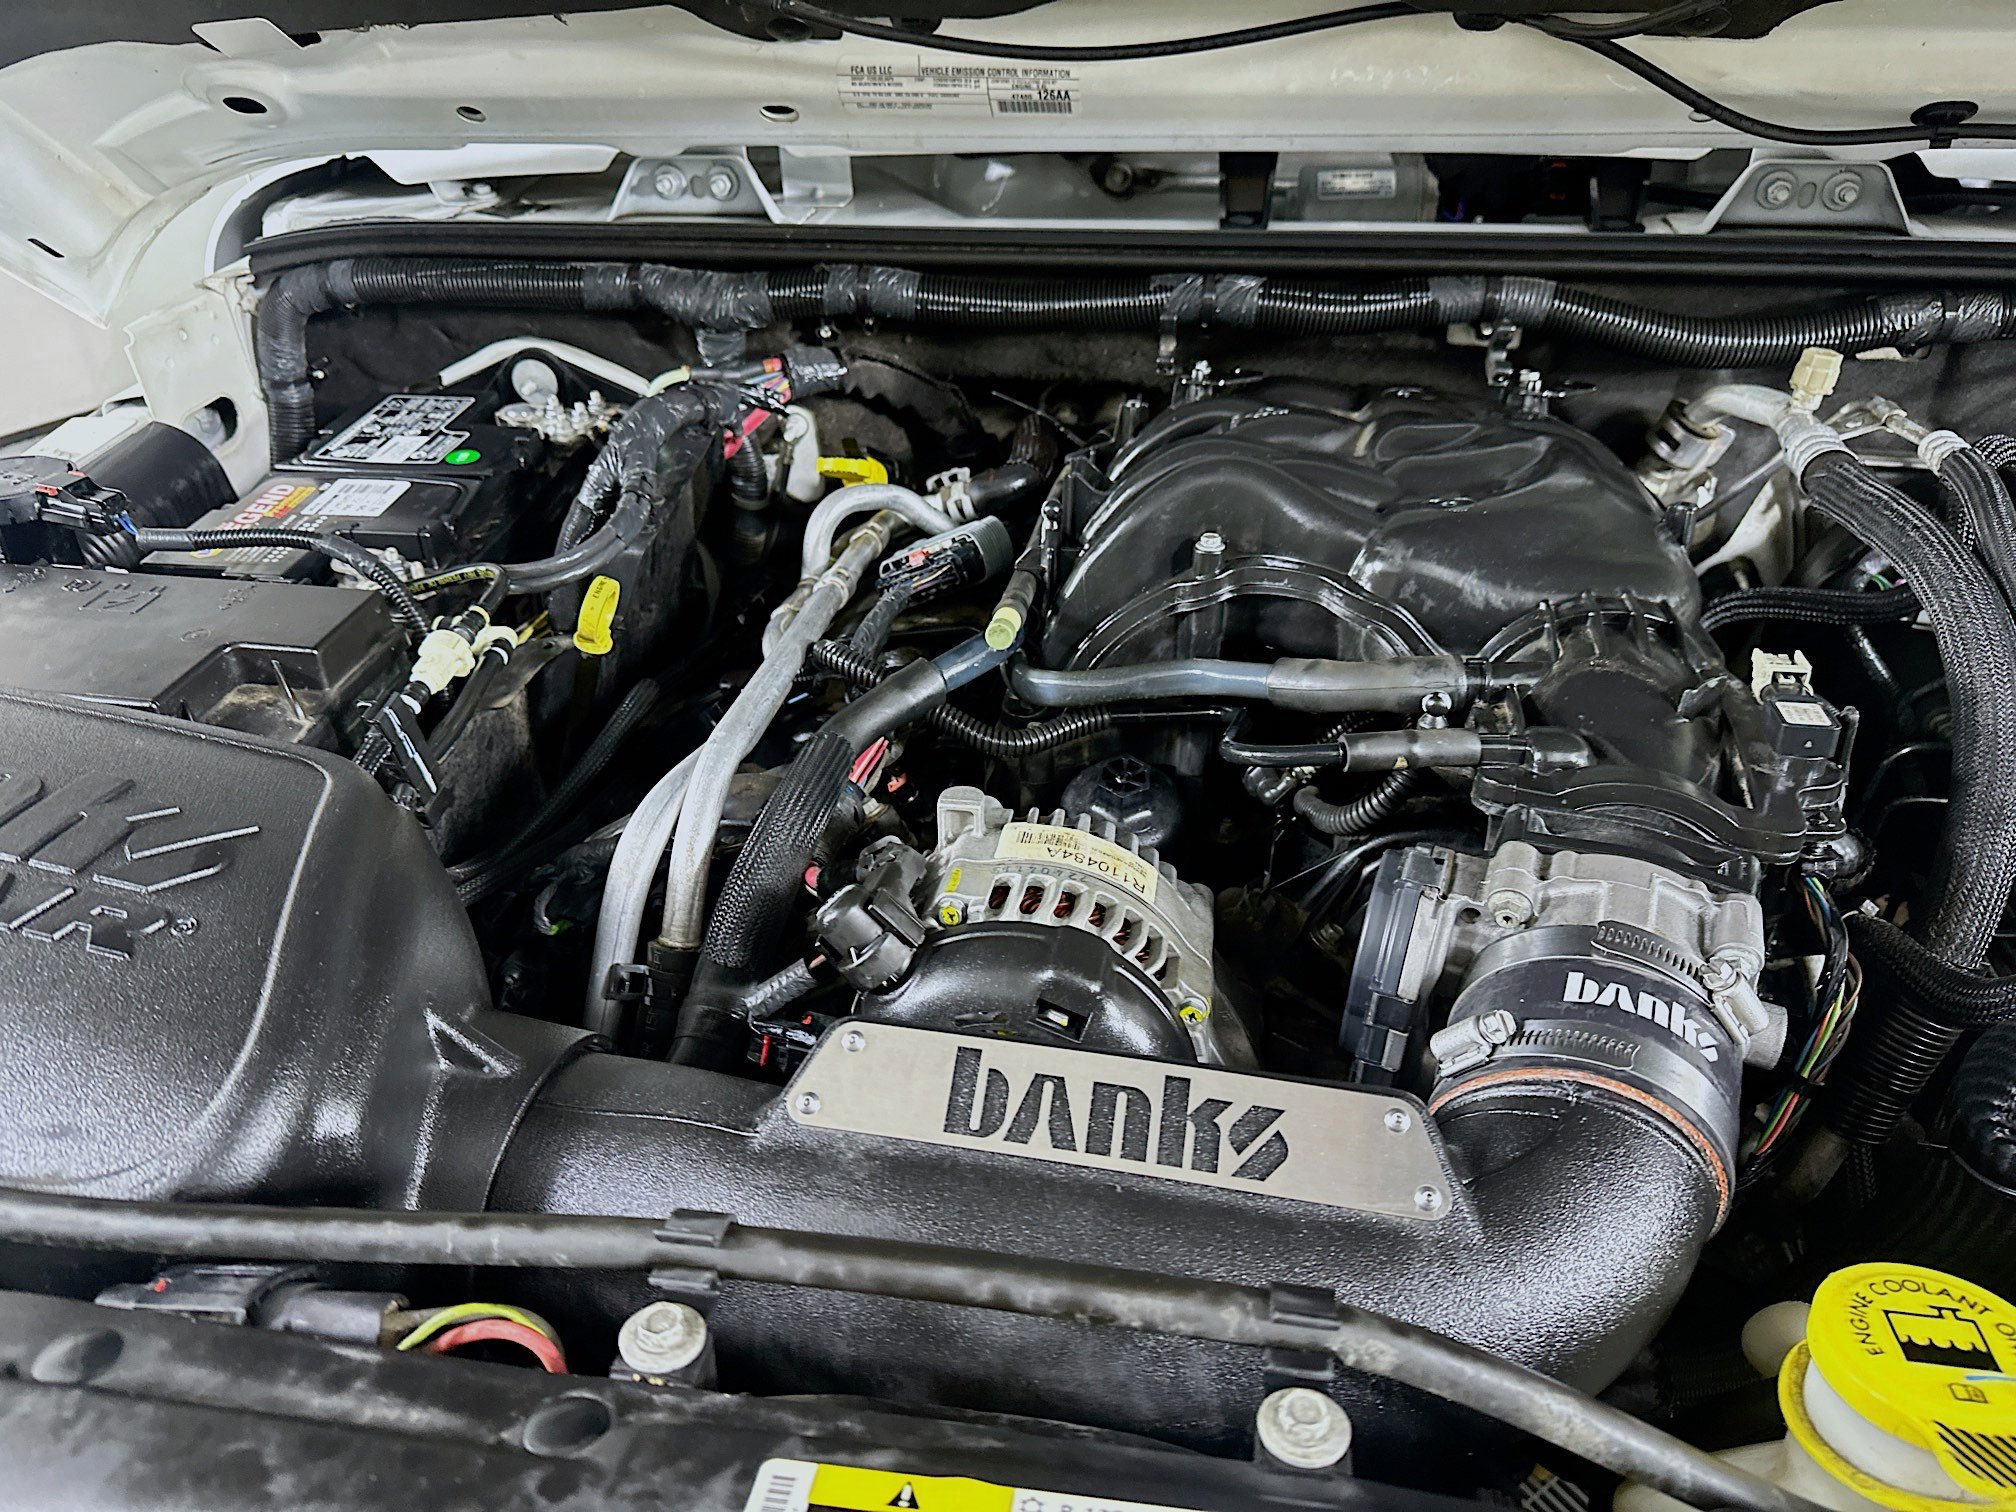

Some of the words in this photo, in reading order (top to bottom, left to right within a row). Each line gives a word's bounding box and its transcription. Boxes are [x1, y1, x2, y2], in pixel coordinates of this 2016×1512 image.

[850, 65, 864, 75] FCA
[866, 66, 877, 75] US
[879, 66, 892, 75] LLC
[921, 66, 949, 76] VEHICLE
[951, 67, 985, 77] EMISSION
[987, 68, 1018, 78] CONTROL
[1021, 69, 1071, 79] INFORMATION
[1037, 89, 1071, 101] 126AA
[216, 483, 297, 531] EGEND
[1562, 971, 1720, 1063] banks
[944, 1045, 1289, 1182] banks
[1848, 1291, 1886, 1356] ENGINE
[1869, 1279, 1993, 1315] COOLANT
